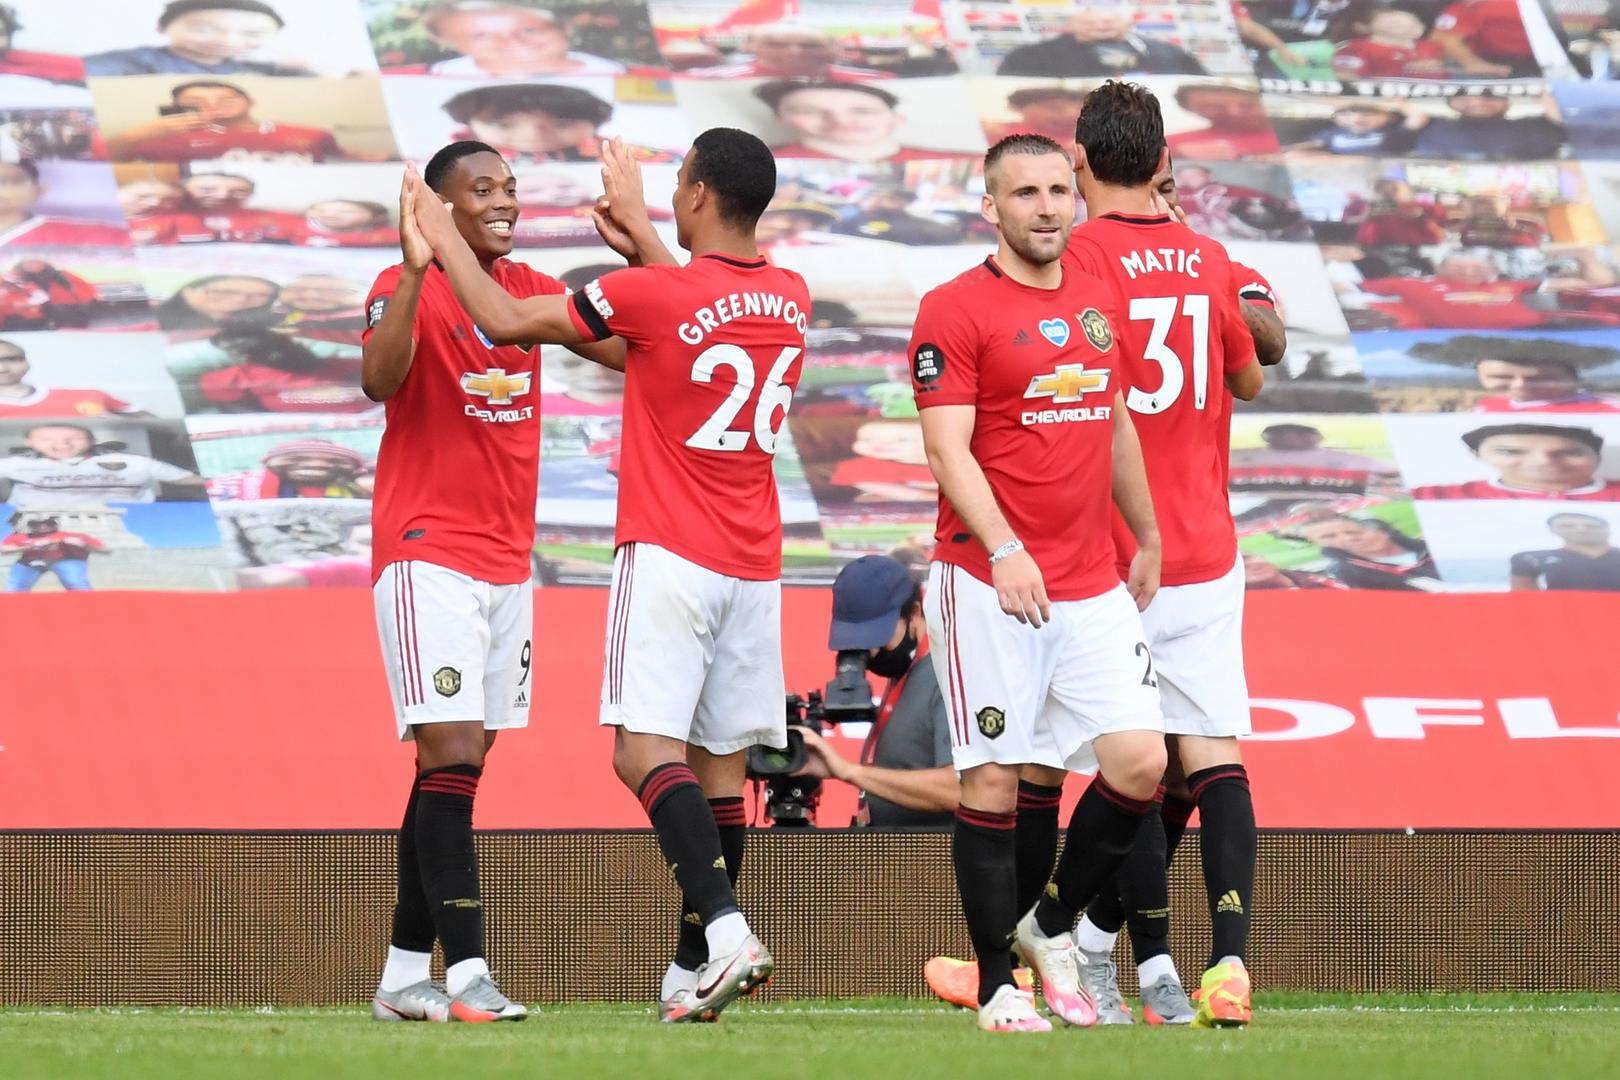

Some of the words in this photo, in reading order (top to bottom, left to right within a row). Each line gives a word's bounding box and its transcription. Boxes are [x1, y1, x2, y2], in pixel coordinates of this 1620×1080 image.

[1120, 248, 1202, 279] MATIĆ
[678, 292, 808, 345] GREENWOO
[1126, 295, 1209, 415] 31
[685, 343, 802, 455] 26
[1021, 406, 1112, 426] CHEVROLET
[517, 639, 531, 687] 9
[1135, 641, 1157, 688] 2
[1236, 696, 1620, 742] OFL
